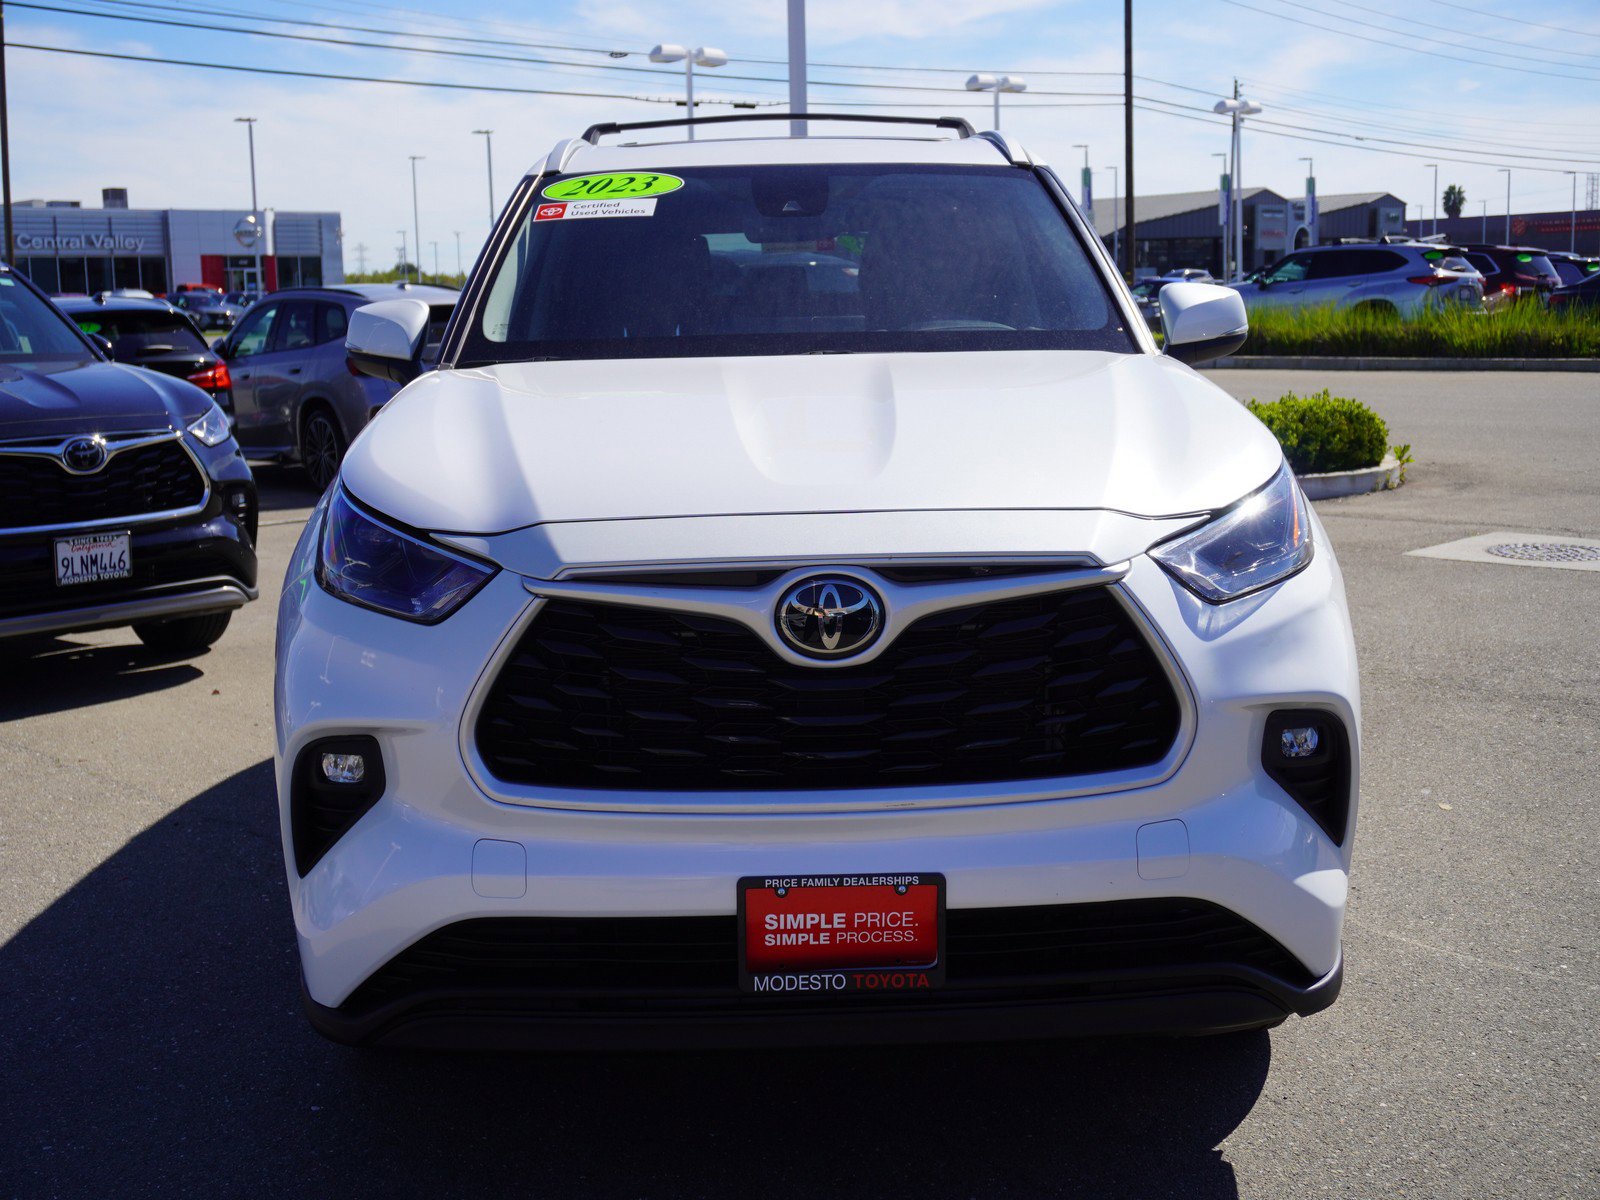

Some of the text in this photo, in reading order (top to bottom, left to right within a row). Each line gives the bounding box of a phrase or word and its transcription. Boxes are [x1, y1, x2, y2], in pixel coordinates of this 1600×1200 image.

[561, 175, 660, 197] 2023
[570, 207, 646, 217] Used Vehicles
[573, 201, 620, 210] Certified
[16, 233, 145, 251] Central Valley
[61, 550, 126, 578] 9LNM446
[61, 570, 128, 585] MODESTO TOYOTA
[765, 876, 919, 888] PRICE FAMILY DEALERSHIPS
[764, 911, 919, 930] SIMPLE PRICE.
[764, 930, 918, 946] SIMPLE PROCESS.
[754, 973, 930, 992] MODESTO TOYOTA
